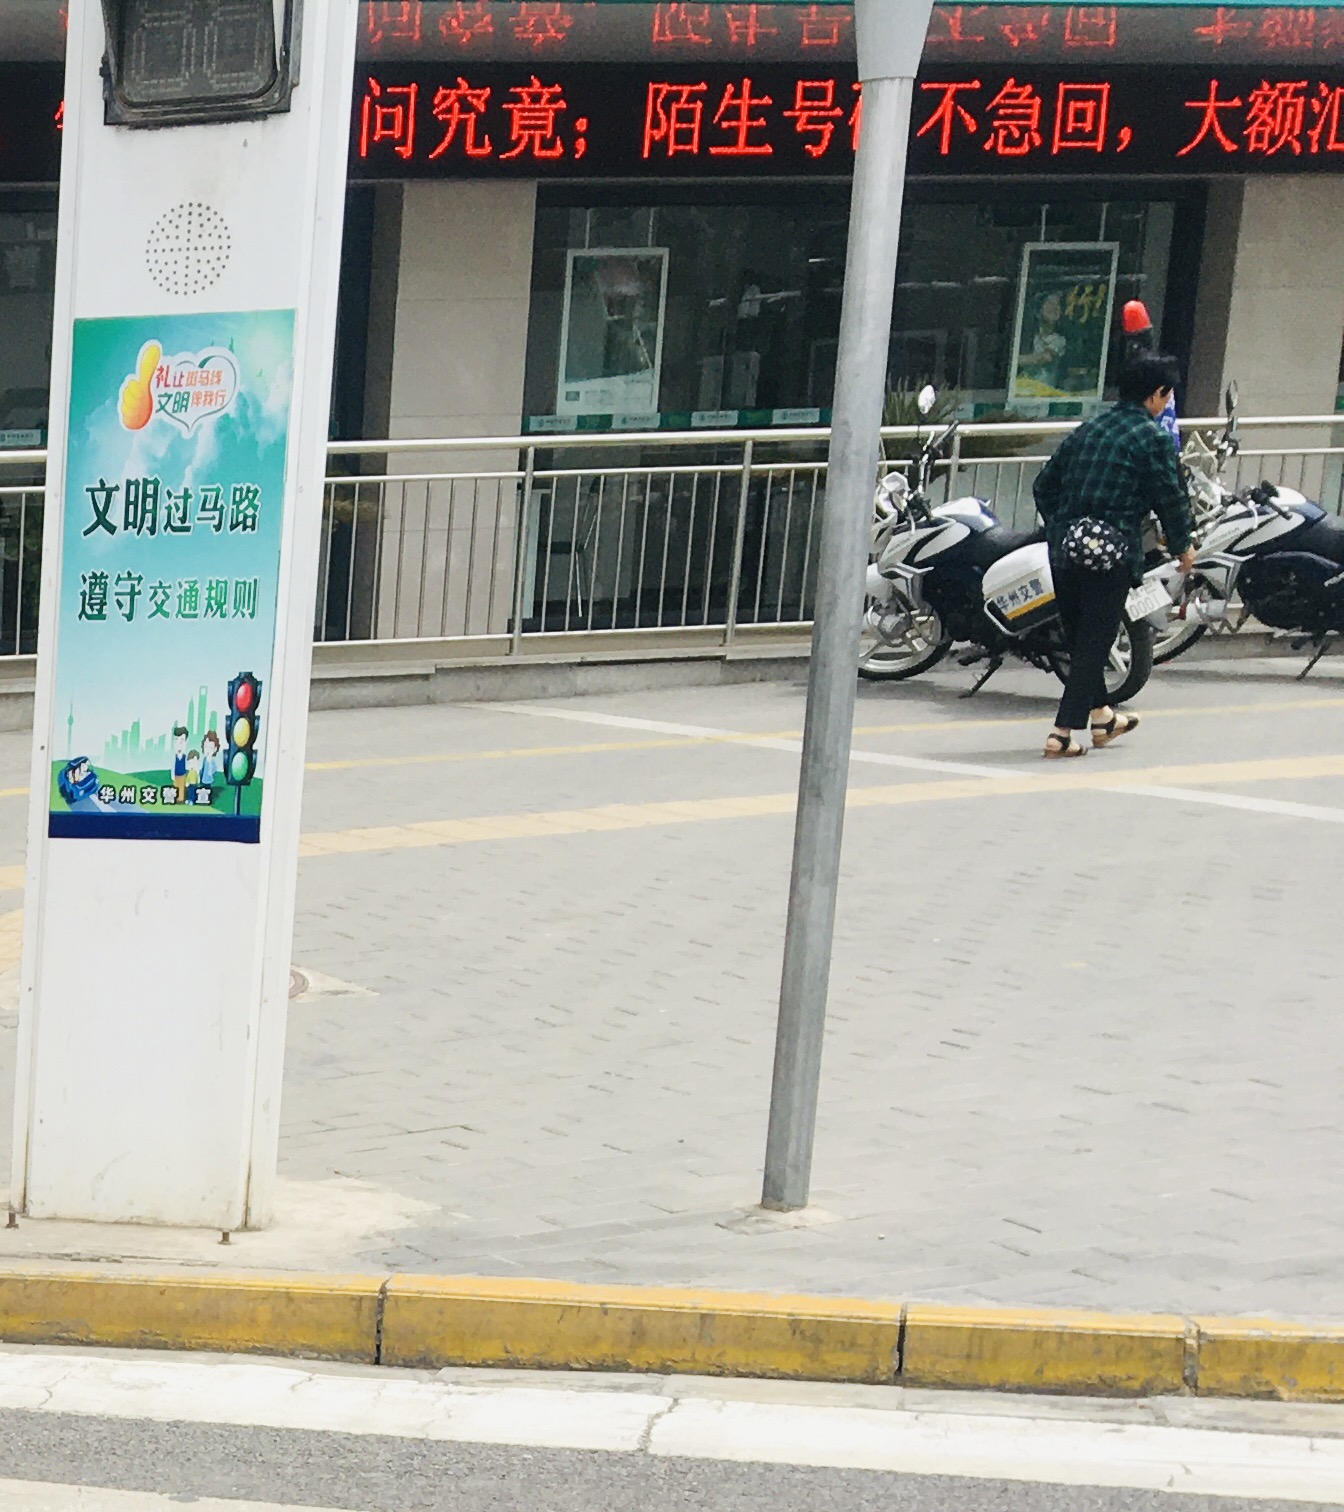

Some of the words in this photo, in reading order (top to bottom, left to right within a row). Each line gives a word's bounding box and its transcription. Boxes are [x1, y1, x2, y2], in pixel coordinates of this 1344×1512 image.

[81, 477, 262, 538] 文明过马路
[77, 570, 259, 623] 遵守交通规则
[98, 785, 179, 805] 华州交警
[195, 785, 212, 806] 宣
